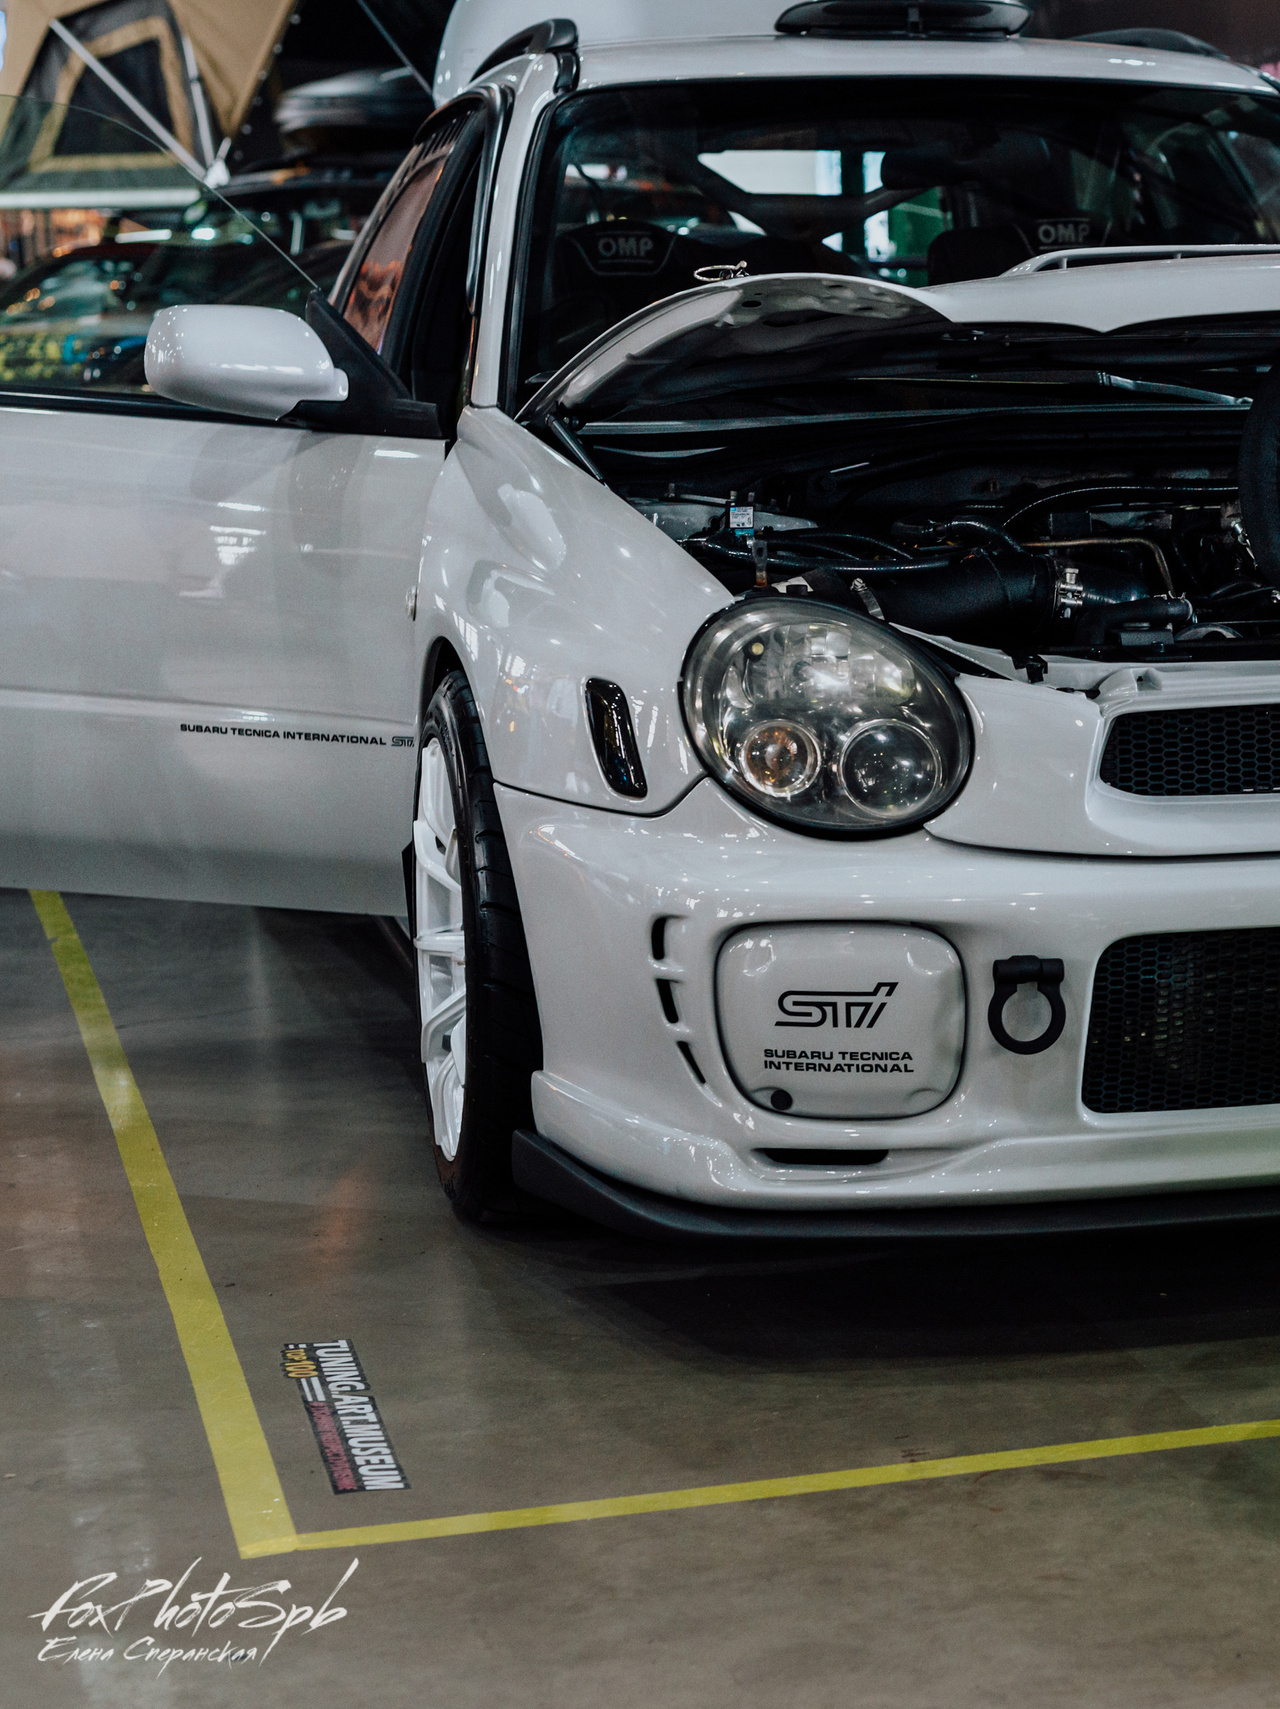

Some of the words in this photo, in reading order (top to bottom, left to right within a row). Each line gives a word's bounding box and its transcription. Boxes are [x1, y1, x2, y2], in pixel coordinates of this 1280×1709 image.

[1038, 223, 1090, 244] OMP
[598, 237, 654, 257] OMP
[180, 723, 229, 735] SUBARU
[230, 727, 281, 739] TECNICA
[283, 731, 387, 746] INTERNATIONAL
[763, 1048, 834, 1061] SUBARU
[838, 1051, 913, 1062] TECNICA
[763, 1060, 915, 1074] INTERNATIONAL
[284, 1360, 319, 1378] 100
